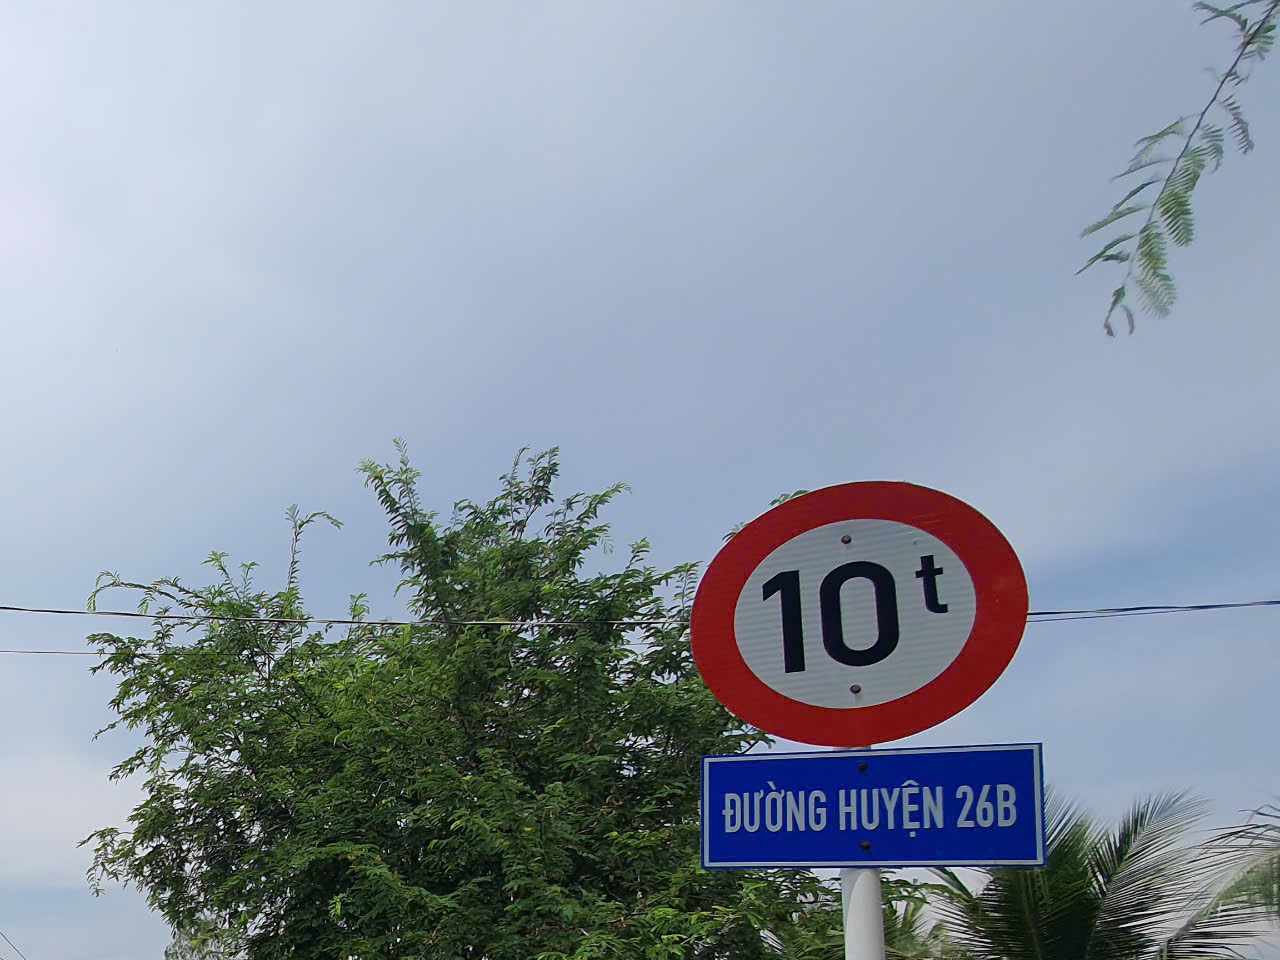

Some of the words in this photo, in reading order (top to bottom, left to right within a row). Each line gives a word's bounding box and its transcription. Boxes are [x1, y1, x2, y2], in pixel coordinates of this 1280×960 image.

[722, 781, 827, 833] ĐƯỜNG
[839, 780, 944, 838] HUYỆN
[956, 783, 1017, 828] 26B
